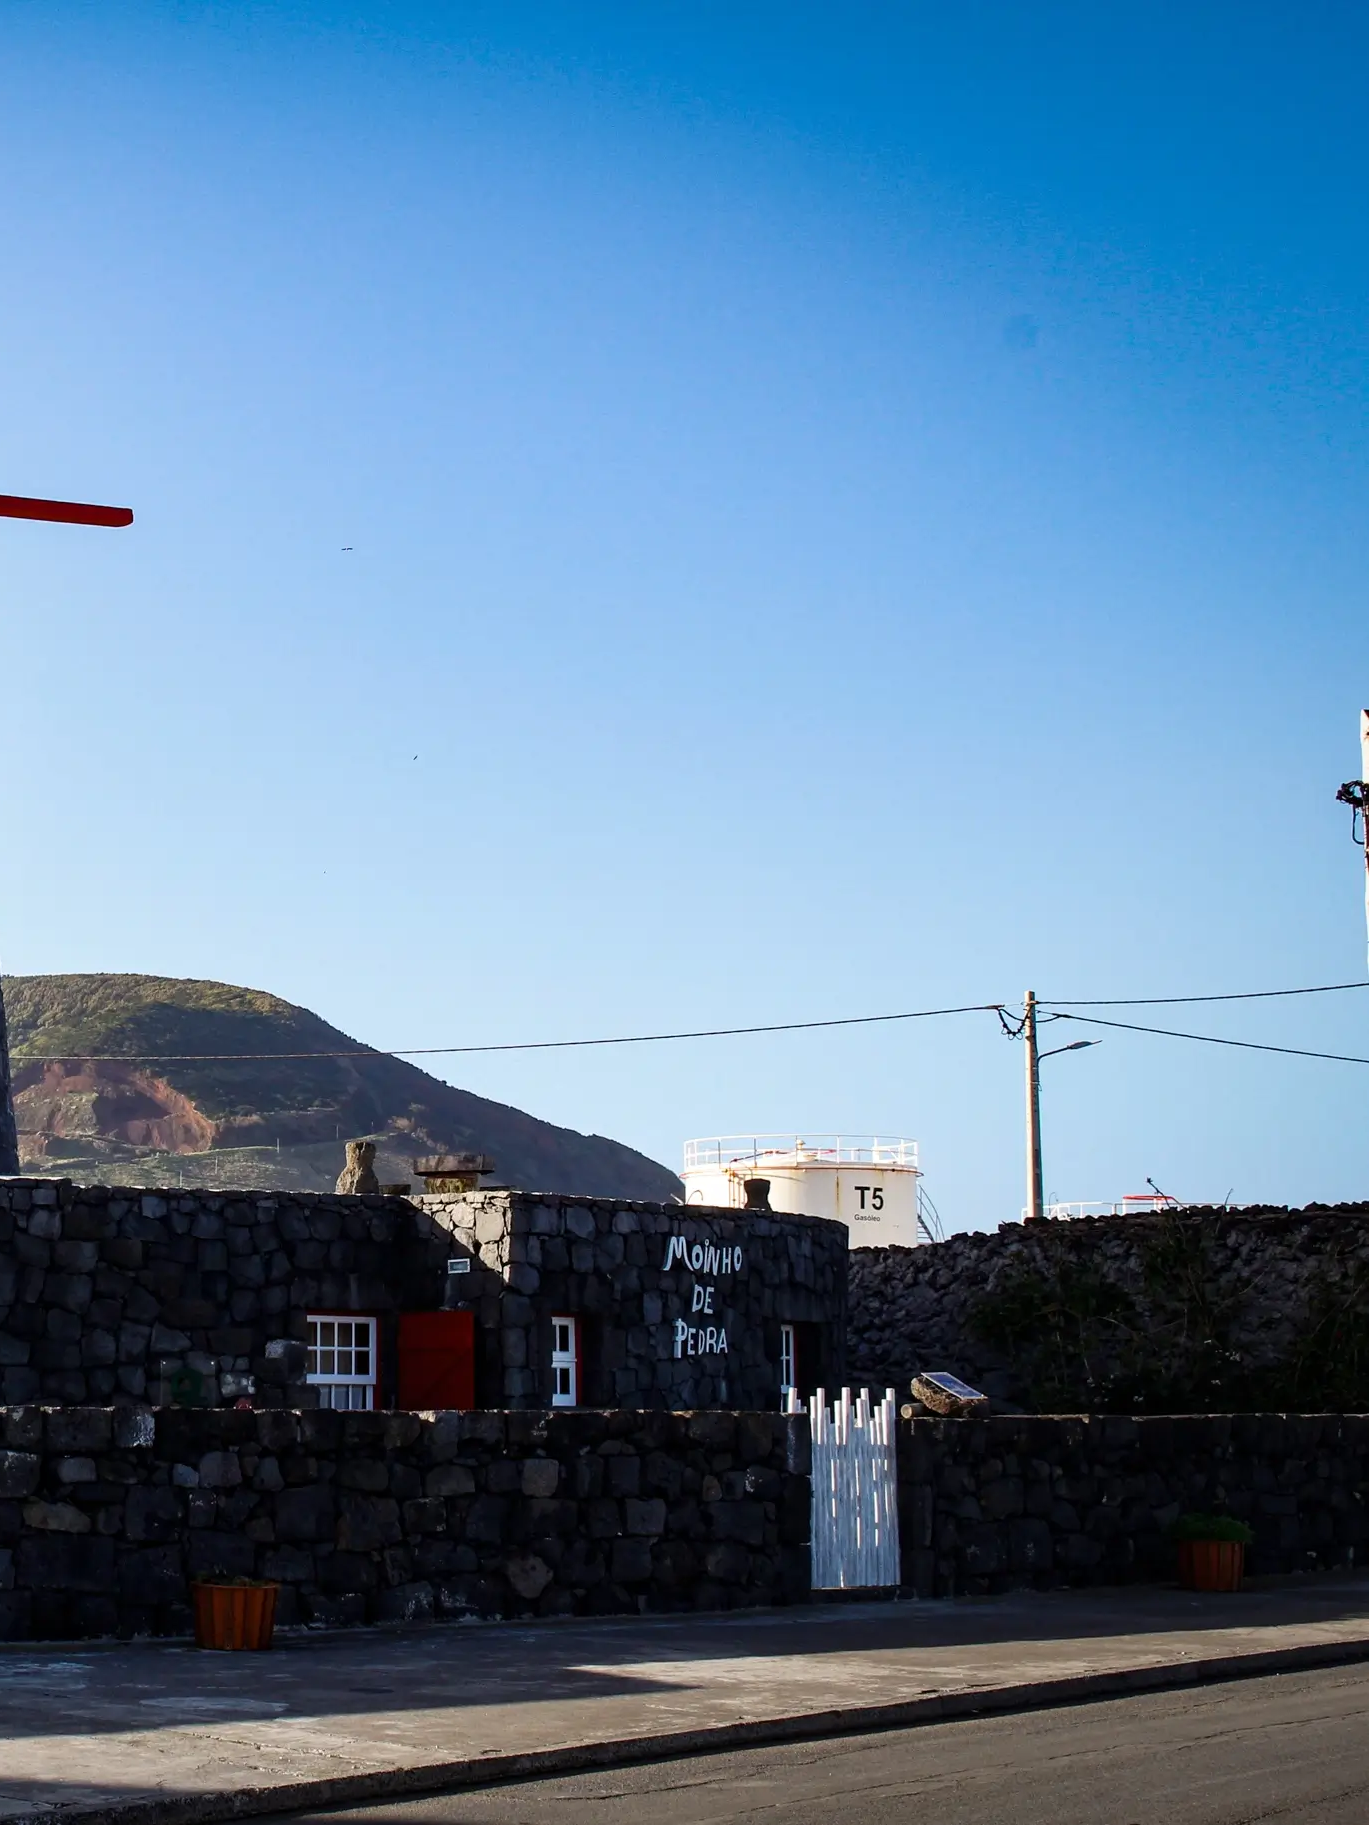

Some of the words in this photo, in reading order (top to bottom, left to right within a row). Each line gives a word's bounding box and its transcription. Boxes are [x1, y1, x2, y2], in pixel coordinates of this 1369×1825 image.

[854, 1186, 884, 1211] T5
[854, 1214, 881, 1222] Gasóleo
[691, 1284, 715, 1314] DE
[673, 1318, 728, 1358] PEDRA
